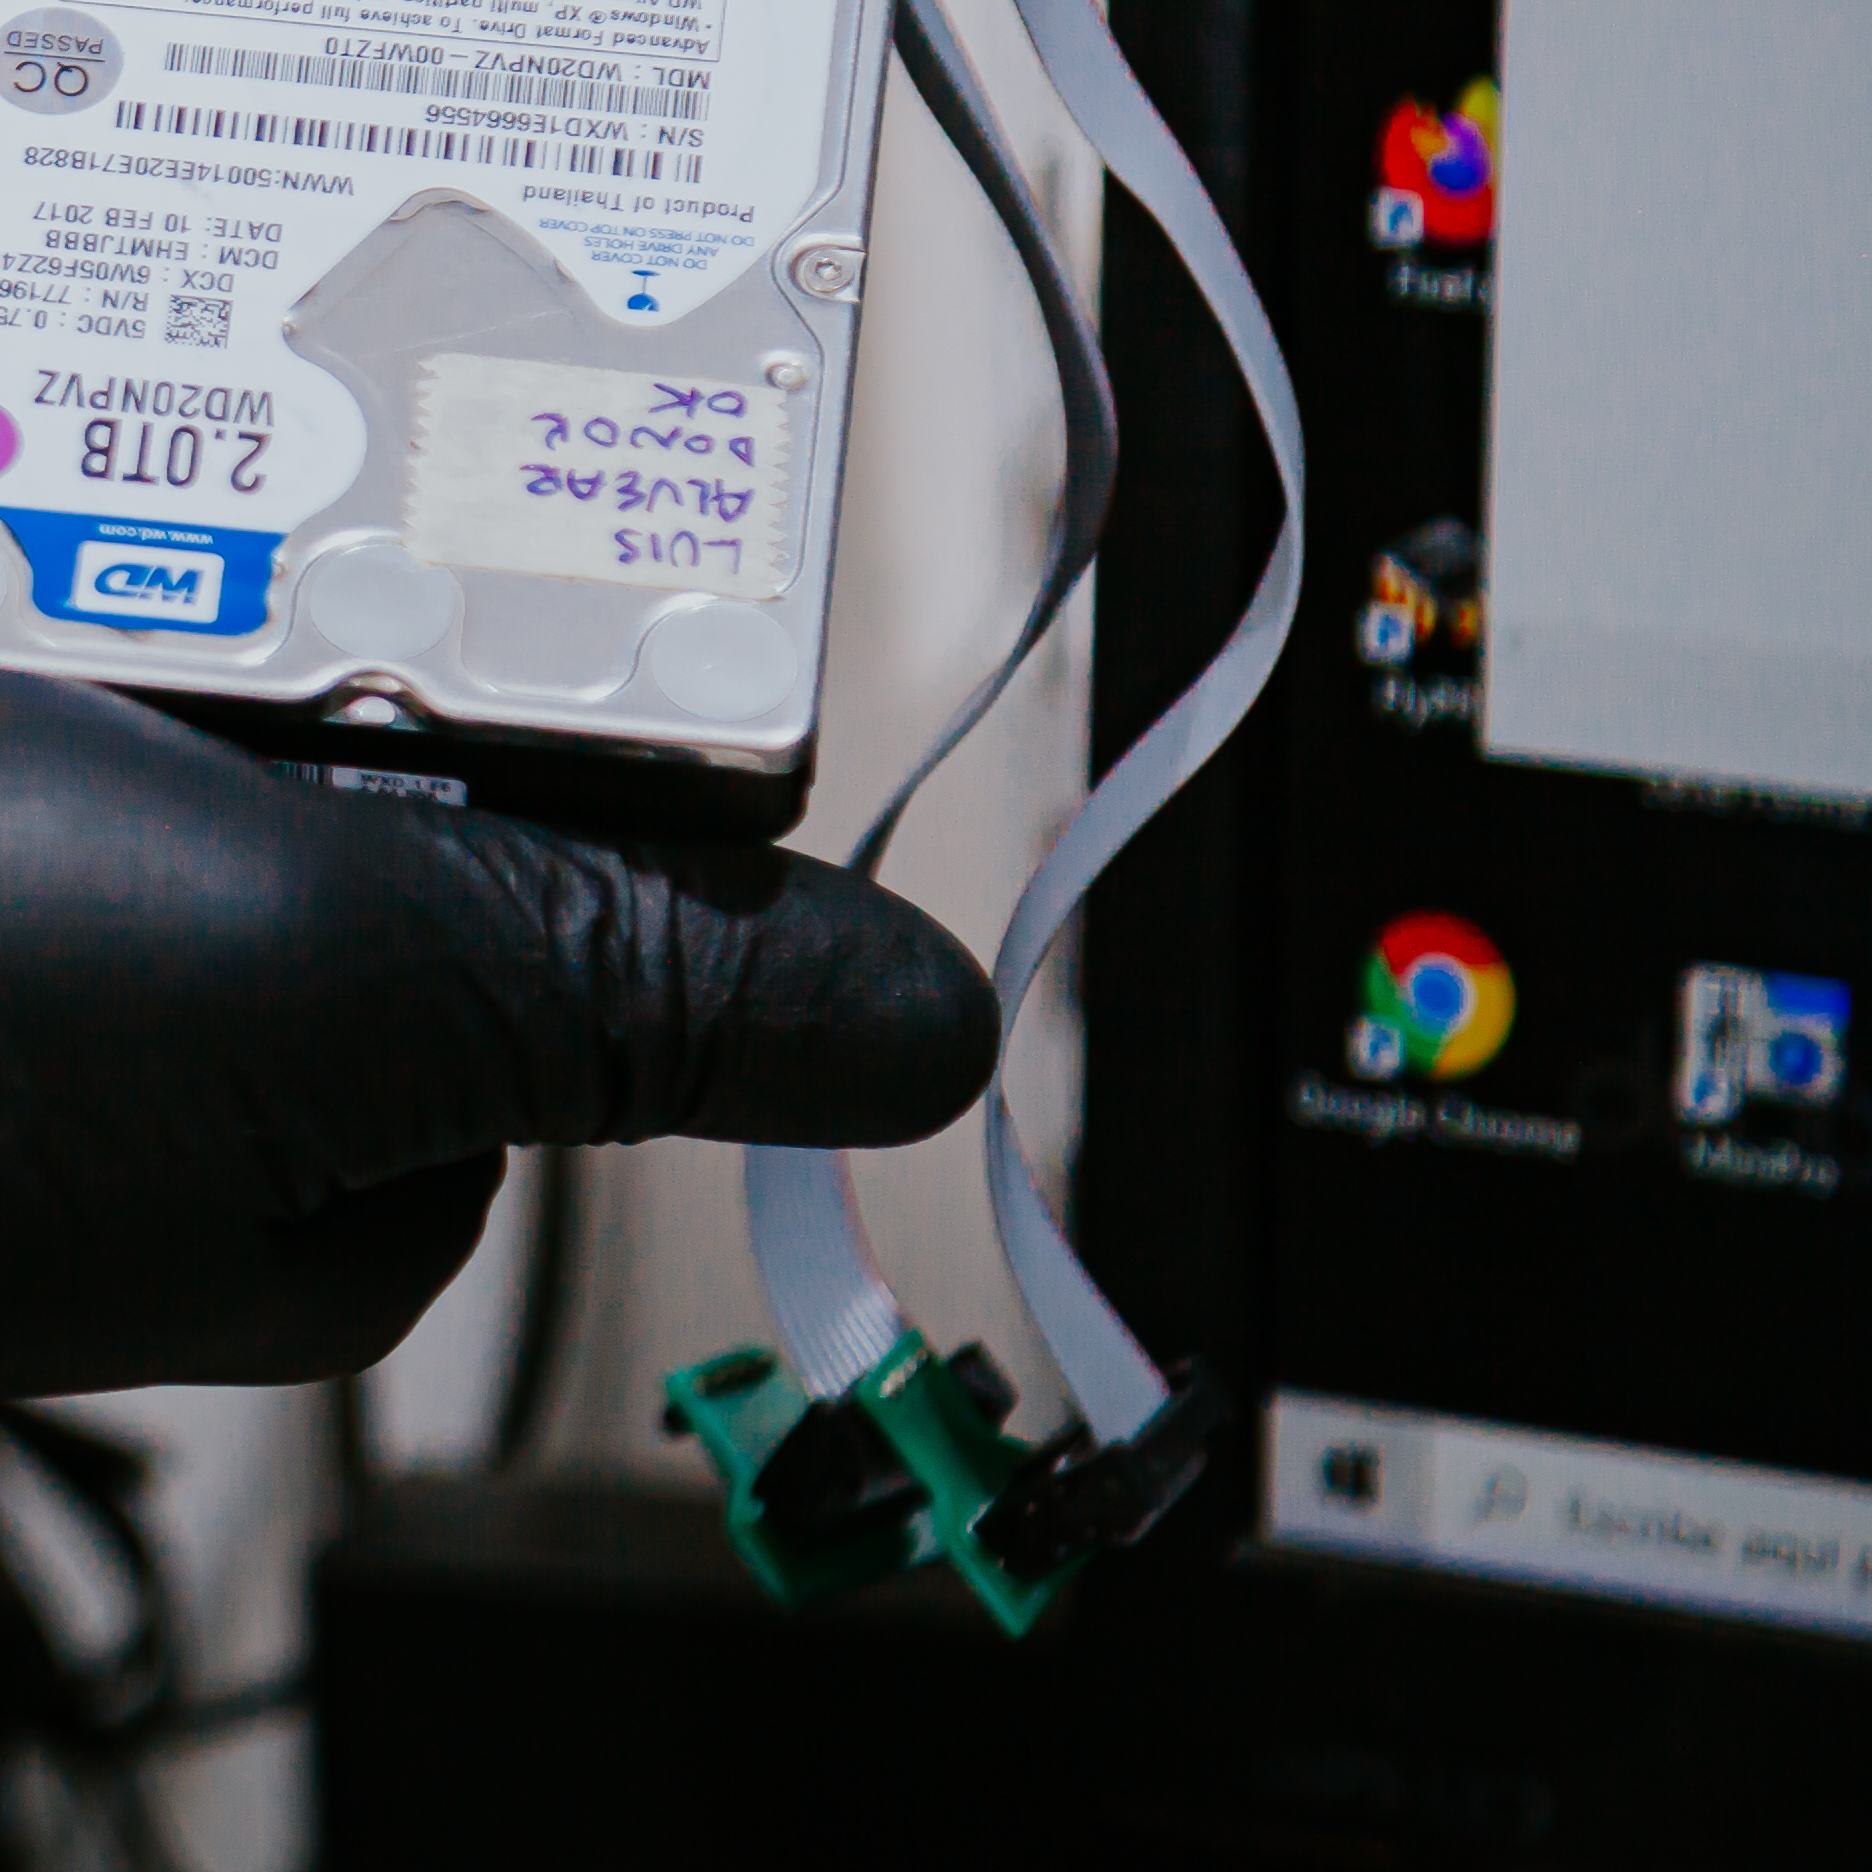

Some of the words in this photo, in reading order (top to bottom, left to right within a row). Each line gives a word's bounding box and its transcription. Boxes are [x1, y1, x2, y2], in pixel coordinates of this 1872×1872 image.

[3, 26, 106, 57] PASSED
[8, 55, 94, 100] QC
[472, 49, 623, 82] WD20NPVZ
[650, 65, 710, 90] MDL
[423, 102, 630, 142] WXD1E6664556
[657, 124, 704, 148] S/N
[521, 183, 625, 212] Thailand
[632, 195, 655, 214] of
[663, 196, 754, 223] Product
[31, 199, 94, 225] 2017
[102, 206, 153, 230] FEB
[162, 212, 193, 234] 10
[204, 215, 282, 243] DATE:
[42, 226, 189, 262] EHMTJBBB
[217, 244, 278, 270] DCM
[0, 249, 151, 286] 6W05F62Z4
[179, 268, 234, 293] DCX
[100, 287, 149, 312] R/N
[74, 312, 146, 340] 5VDC
[32, 364, 278, 432] WD20NPVZ
[646, 381, 747, 425] OK
[76, 411, 271, 499] 2.0TB
[514, 454, 755, 527] ALVEAR
[97, 520, 213, 548] www.wd.com
[610, 521, 742, 578] LUIS
[92, 556, 203, 607] WD
